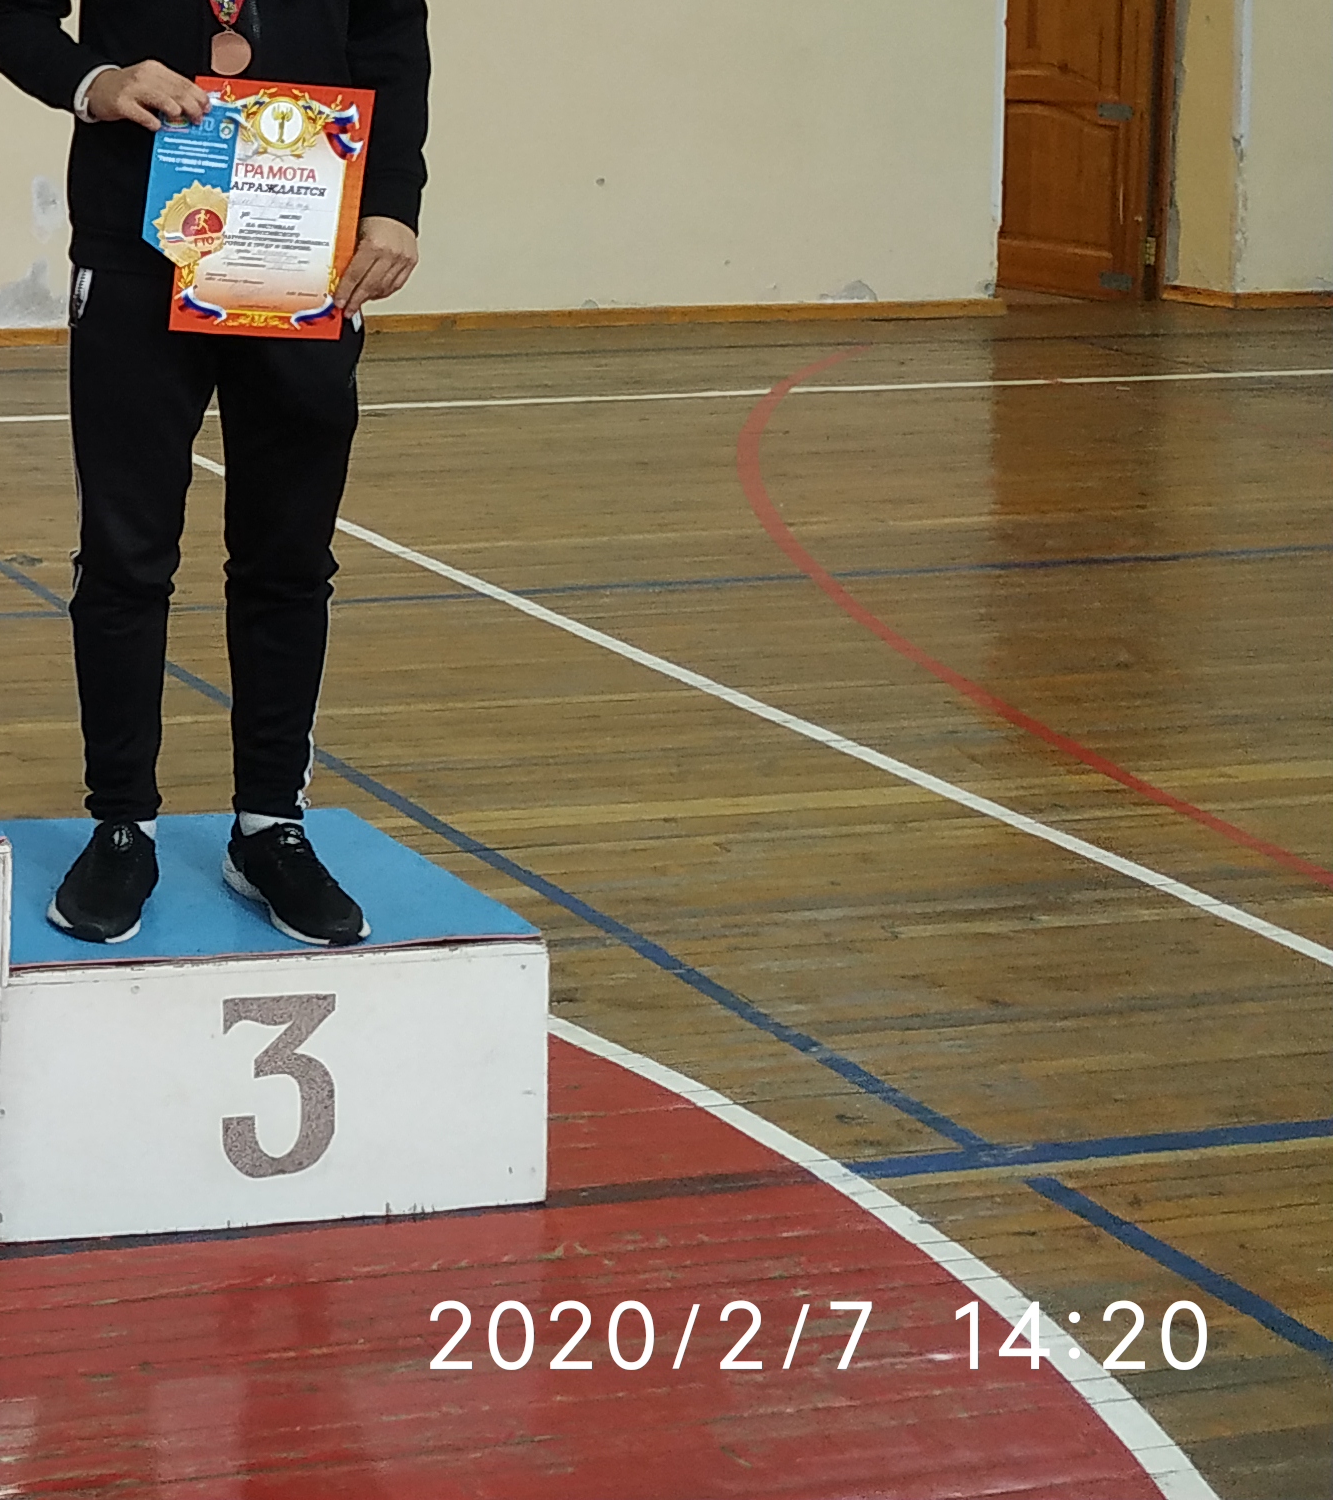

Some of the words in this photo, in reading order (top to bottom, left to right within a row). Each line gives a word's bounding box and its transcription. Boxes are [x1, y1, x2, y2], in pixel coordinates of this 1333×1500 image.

[235, 162, 317, 183] ГРАМОТА
[231, 180, 327, 197] АГРАЖДАЕТСЯ
[194, 236, 215, 248] ГТО
[222, 993, 336, 1179] 3
